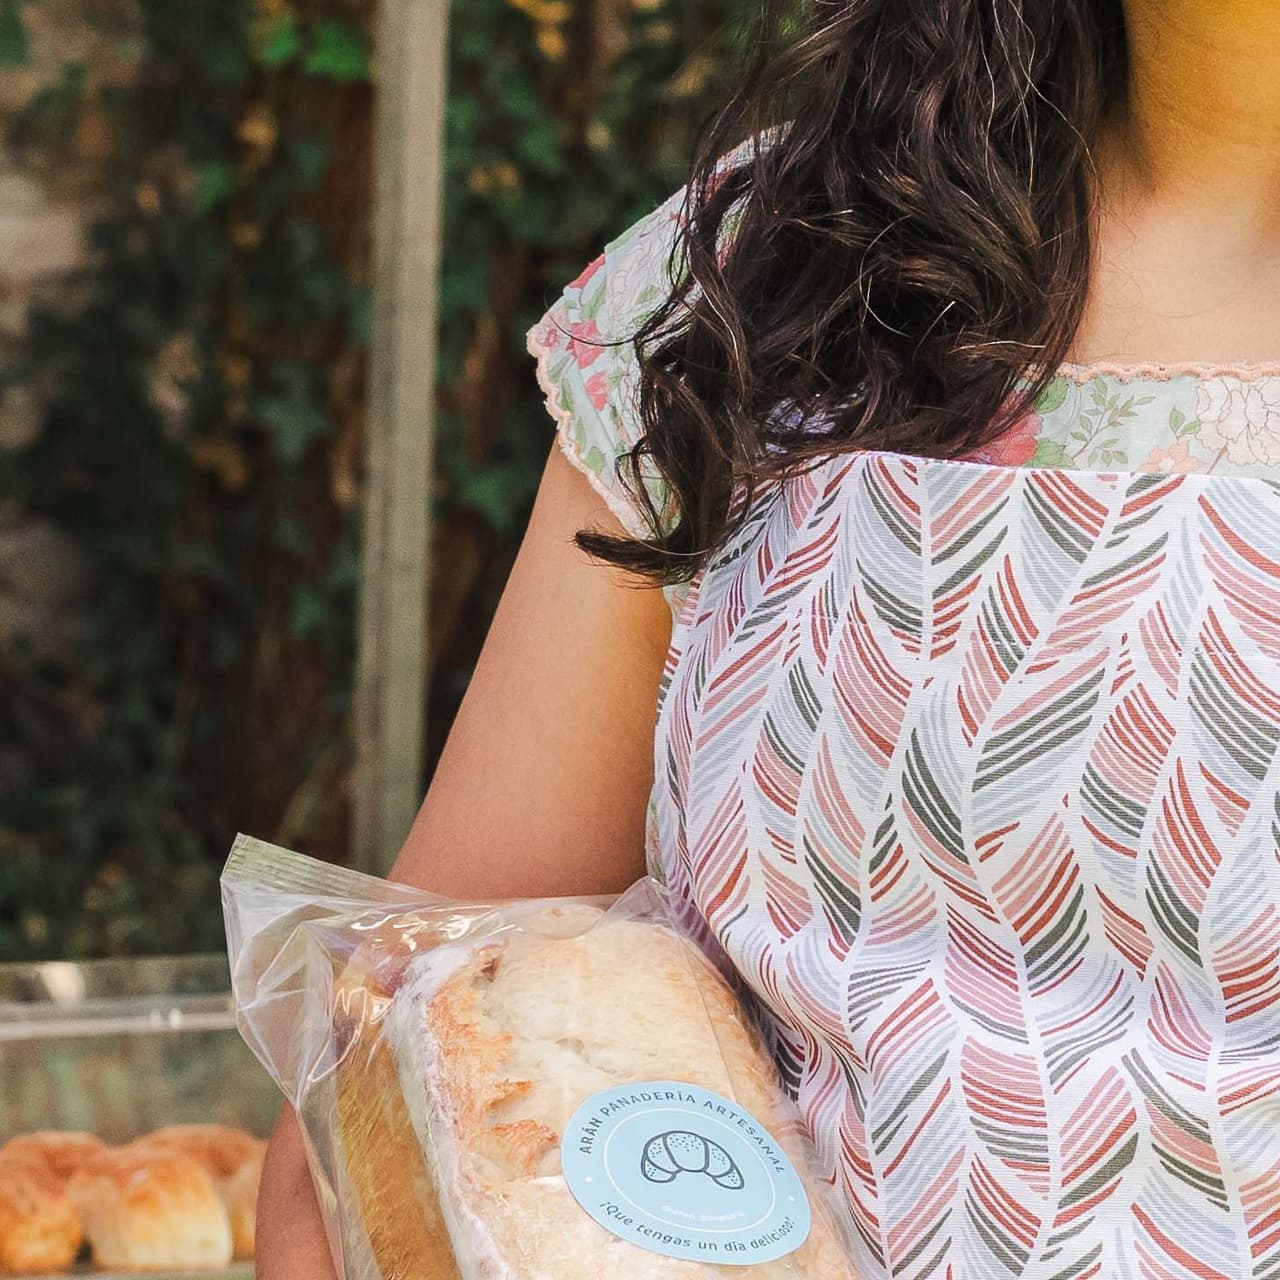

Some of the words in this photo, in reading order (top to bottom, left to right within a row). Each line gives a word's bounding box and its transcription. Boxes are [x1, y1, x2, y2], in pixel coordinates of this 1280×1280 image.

[578, 1118, 603, 1155] ARÁN
[600, 1091, 696, 1118] PANADERÍA
[704, 1101, 785, 1173] ARTESANAL
[600, 1201, 633, 1226] ¡Que
[637, 1224, 690, 1248] tengas
[698, 1241, 718, 1251] un
[724, 1240, 746, 1252] día
[751, 1217, 798, 1248] delicioso!
